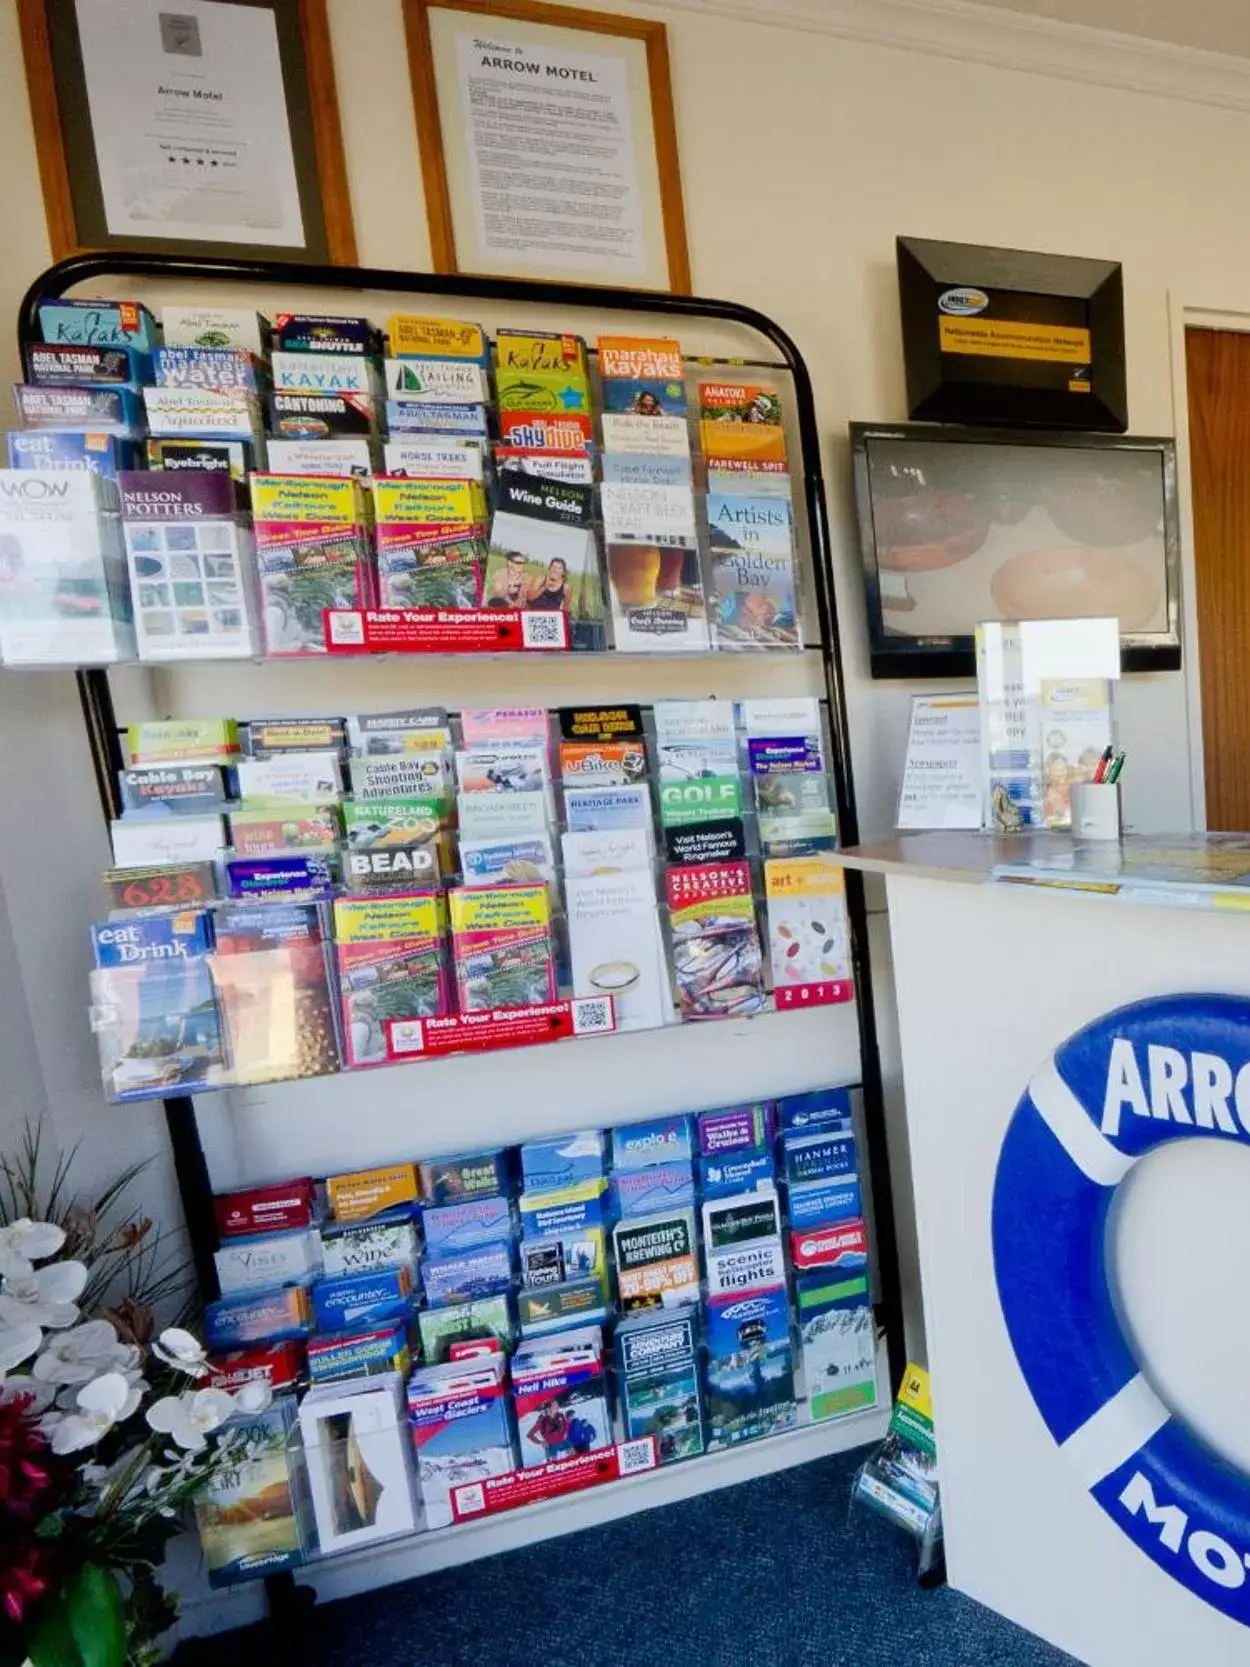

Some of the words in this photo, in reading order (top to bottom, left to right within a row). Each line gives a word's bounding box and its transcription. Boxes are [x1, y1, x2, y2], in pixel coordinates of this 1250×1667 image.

[481, 56, 540, 74] ARROW
[546, 65, 597, 82] MOTEL
[158, 85, 190, 97] Arrow
[193, 90, 223, 100] Motel
[508, 344, 571, 371] Kayaks
[603, 349, 681, 364] marahau
[164, 368, 246, 386] water
[605, 360, 681, 379] kayaks
[281, 373, 360, 388] KAYAK
[275, 396, 345, 412] CANYONING
[14, 436, 54, 453] eat
[35, 455, 99, 472] Drink
[164, 456, 227, 470] Eyebright
[709, 459, 759, 470] FAREWELL
[1, 479, 68, 498] WOW
[123, 491, 182, 503] NELSON
[509, 487, 542, 505] Wine
[545, 496, 583, 514] Guide
[125, 502, 202, 516] POTTERS
[717, 504, 784, 526] Artists
[743, 528, 760, 542] in
[719, 553, 787, 571] Golden
[737, 567, 770, 587] Bay
[366, 612, 400, 622] Rate
[403, 612, 433, 622] Your
[438, 612, 519, 624] Experience!
[126, 772, 177, 785] Cable
[182, 769, 214, 782] Bay
[367, 772, 423, 785] Shooting
[363, 783, 432, 798] Adventures
[663, 785, 736, 804] GOLF
[356, 806, 432, 817] NATURELAND
[388, 816, 436, 832] ZOO
[675, 835, 695, 845] Visit
[697, 831, 733, 842] Nelson's
[674, 843, 701, 853] World
[702, 840, 737, 850] Famous
[351, 852, 432, 874] BEAD
[683, 850, 730, 862] Ringmaker
[671, 869, 744, 883] NELSON'S
[771, 875, 792, 887] art
[672, 878, 745, 892] CREATIVE
[99, 925, 141, 944] eat
[119, 939, 188, 961] Drink
[785, 986, 840, 1001] 2013
[426, 1017, 457, 1029] Rate
[460, 1013, 490, 1025] Your
[493, 1003, 569, 1021] Experience!
[707, 1130, 738, 1140] Walks
[707, 1137, 749, 1150] Cruises
[795, 1144, 848, 1163] HANMER
[621, 1227, 685, 1252] MONTEITH'S
[343, 1247, 392, 1265] Wine
[626, 1244, 672, 1263] BREWING
[717, 1251, 773, 1269] scenic
[720, 1268, 775, 1288] flights
[325, 1288, 390, 1308] encounter
[543, 1377, 567, 1388] Hike
[415, 1404, 444, 1417] West
[448, 1397, 480, 1410] Coast
[444, 1404, 487, 1420] Glaciers
[486, 1476, 514, 1489] Rate
[518, 1469, 545, 1482] Your
[546, 1449, 615, 1473] Experience!
